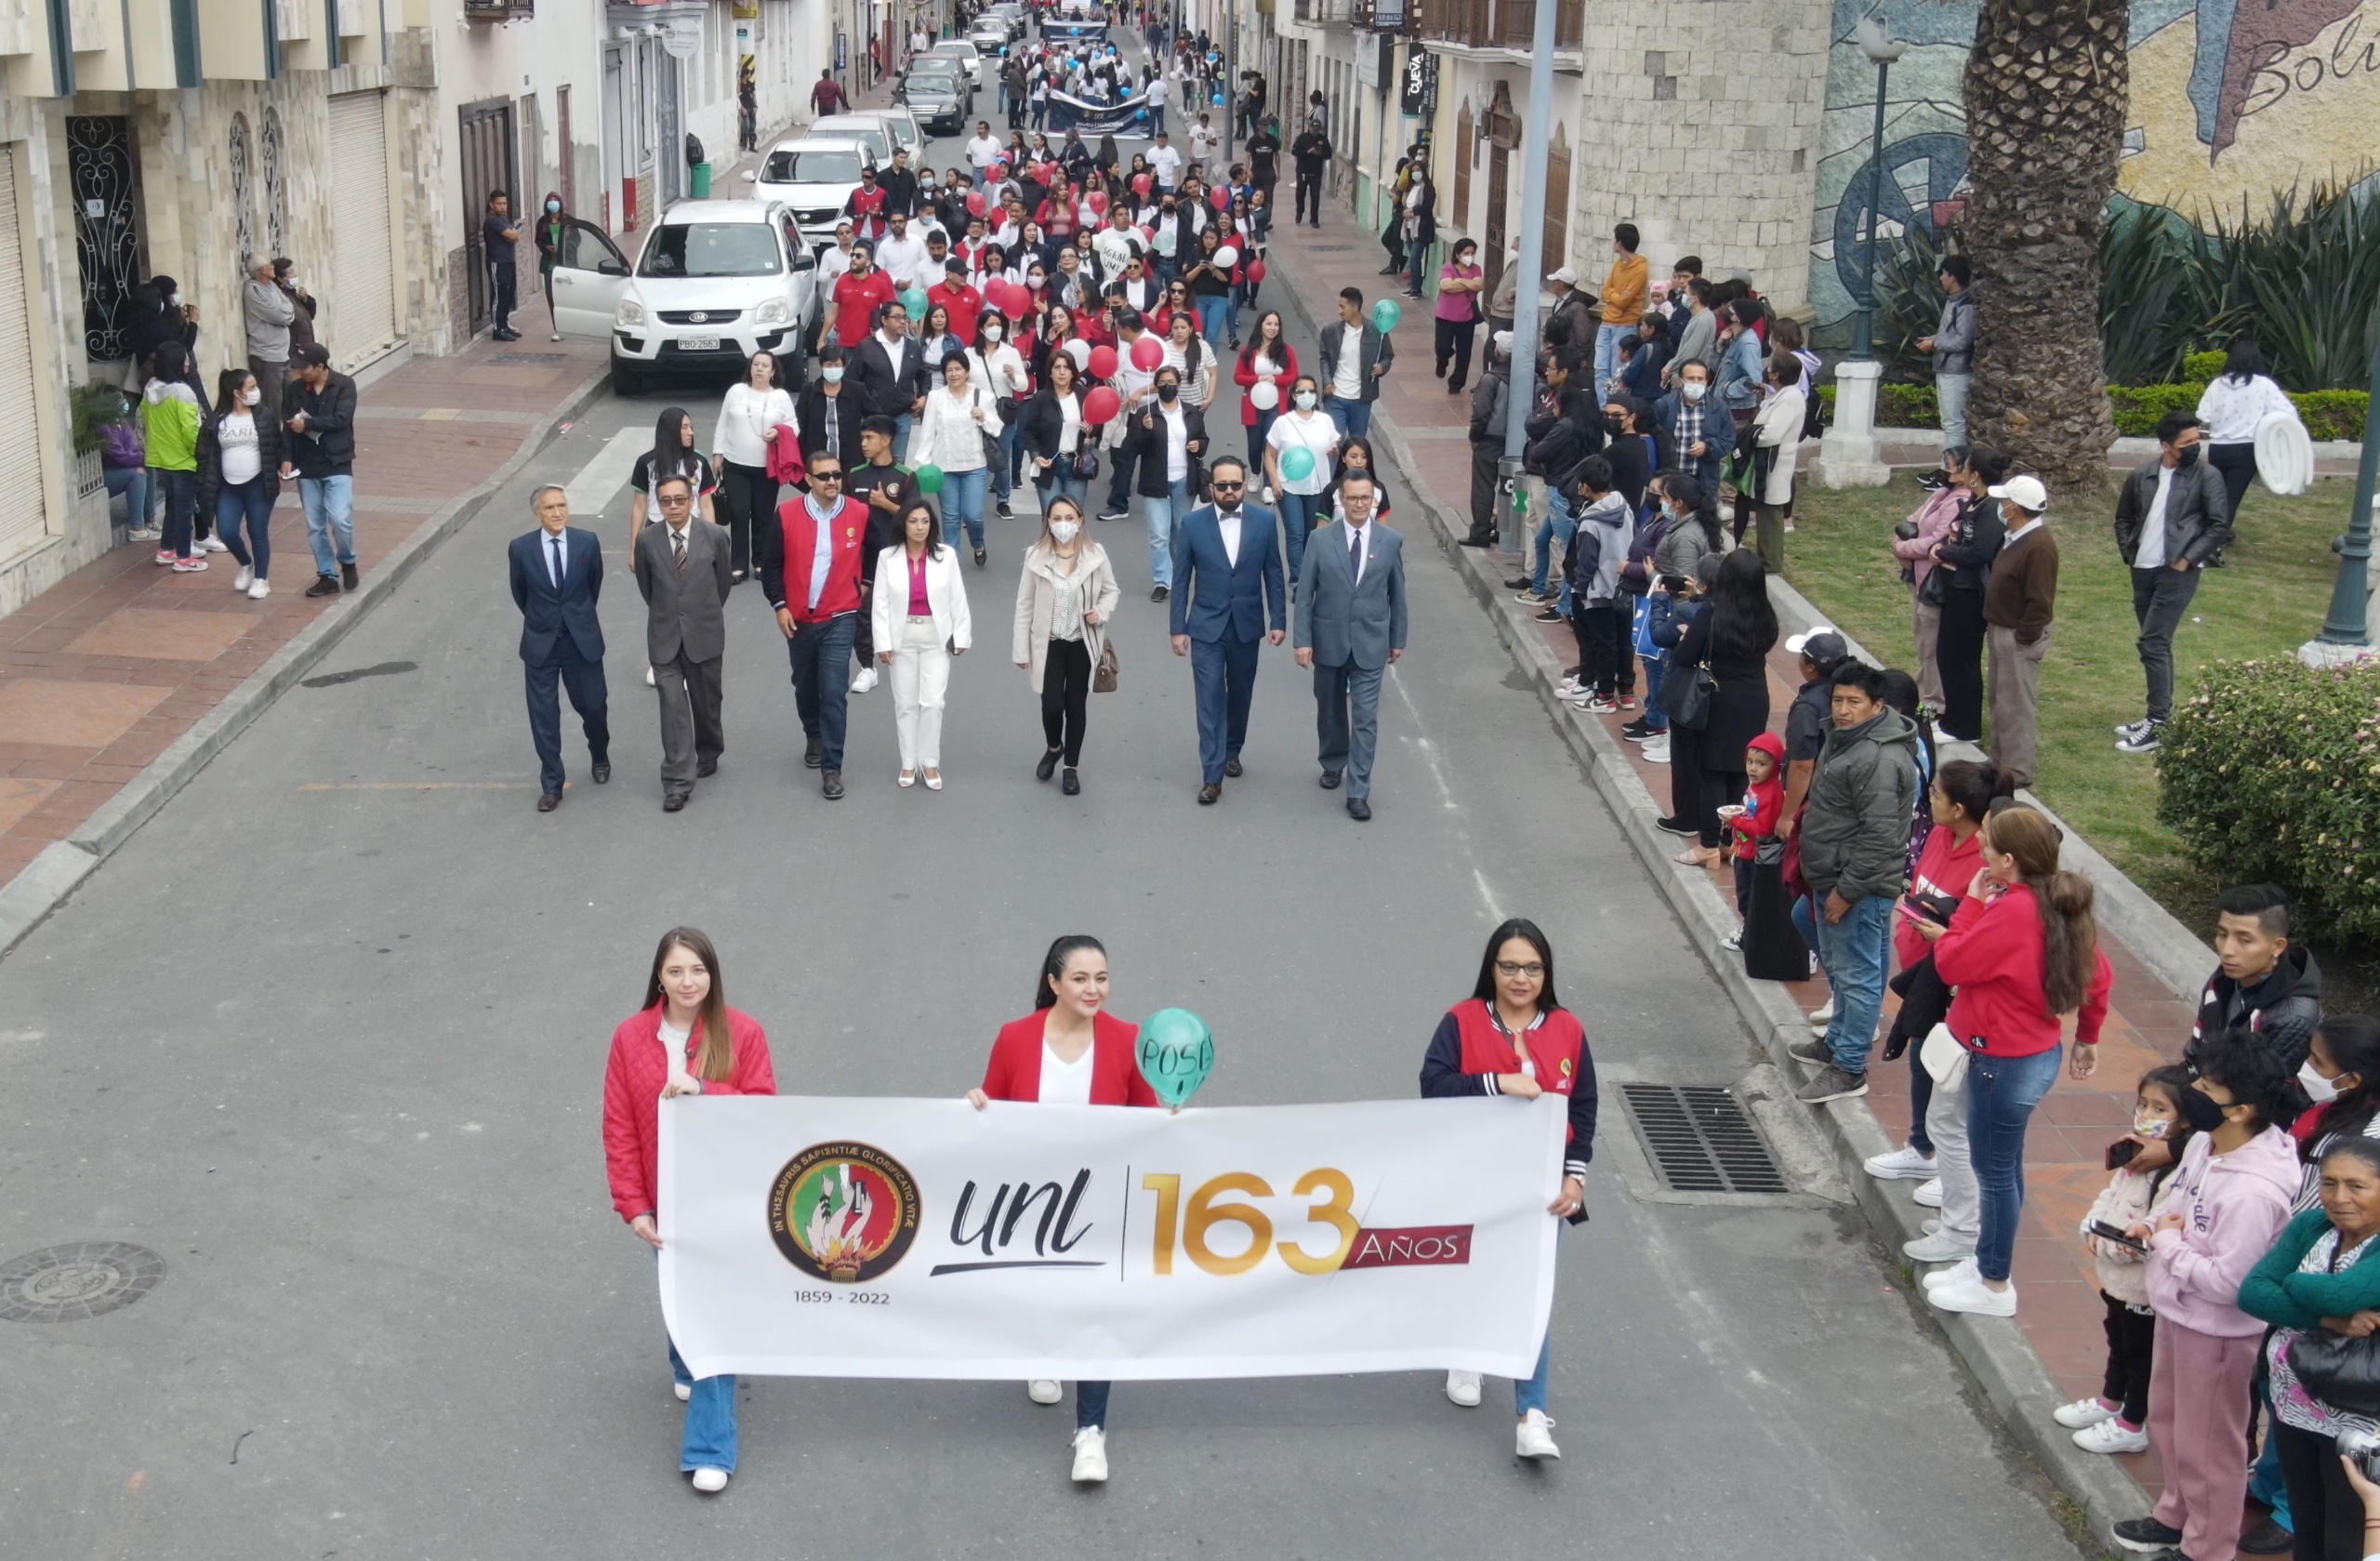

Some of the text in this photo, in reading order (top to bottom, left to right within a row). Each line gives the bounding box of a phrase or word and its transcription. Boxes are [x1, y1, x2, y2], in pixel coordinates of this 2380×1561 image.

[1410, 55, 1421, 94] CUEVA
[692, 312, 707, 322] KIA
[1142, 1167, 1458, 1277] 163 AÑOS
[794, 1290, 832, 1303] 1859
[849, 1292, 890, 1304] 2022
[2125, 1303, 2155, 1316] FILA
